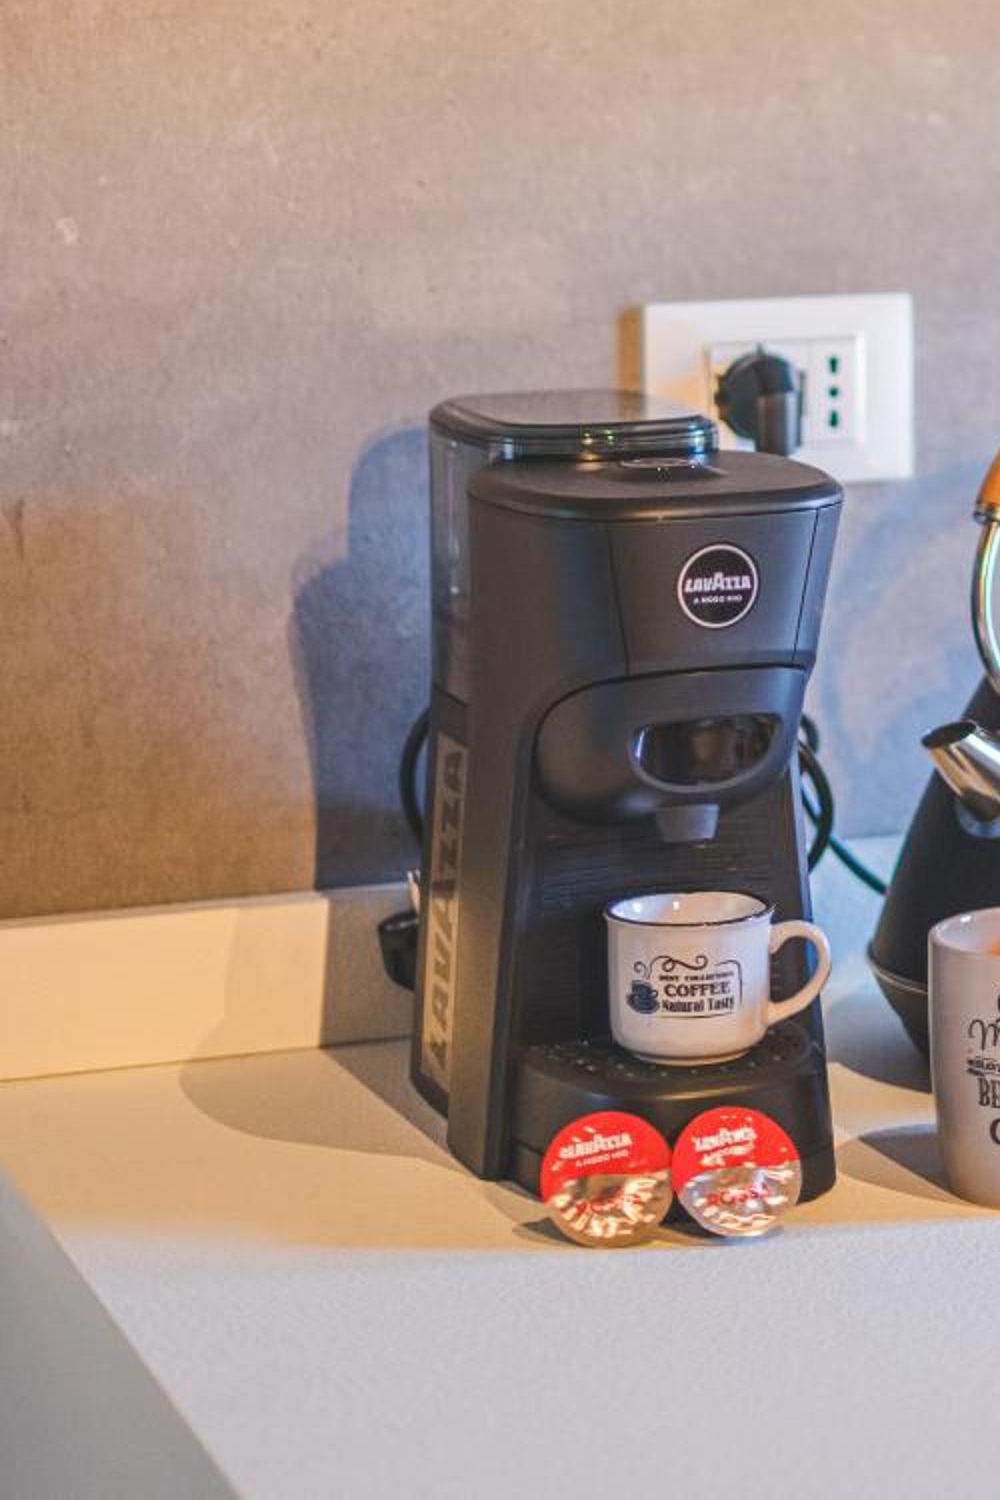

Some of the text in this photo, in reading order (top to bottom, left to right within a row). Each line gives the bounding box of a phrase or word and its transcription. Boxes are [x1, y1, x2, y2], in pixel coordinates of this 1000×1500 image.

[684, 571, 752, 593] LAVAZZA
[664, 981, 731, 998] COFFEE
[661, 998, 705, 1013] Natural
